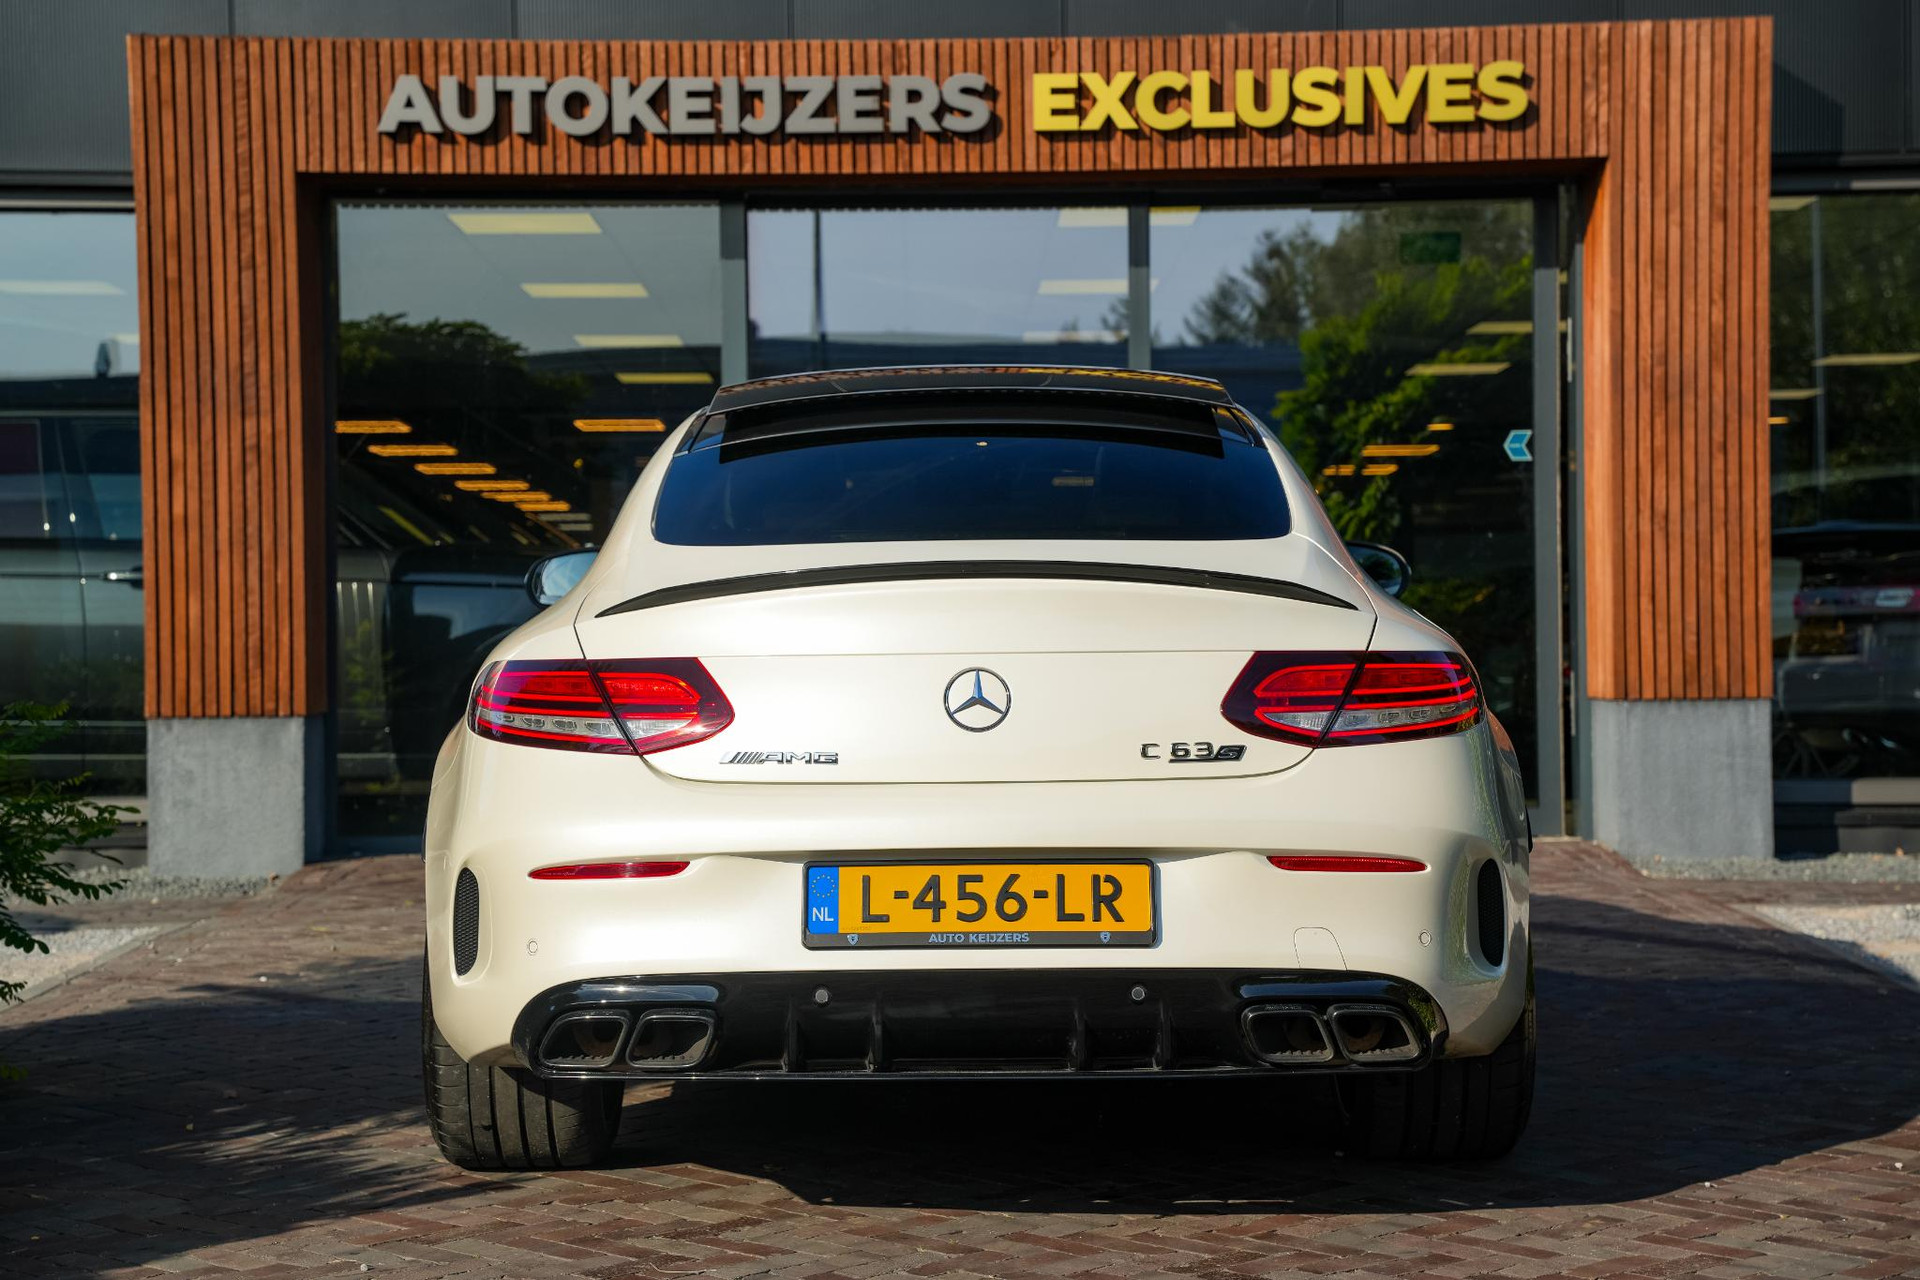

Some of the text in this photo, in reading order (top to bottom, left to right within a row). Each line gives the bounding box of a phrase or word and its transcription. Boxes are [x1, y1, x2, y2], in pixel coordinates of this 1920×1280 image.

[377, 60, 1529, 136] AUTOKEIJZERS EXCLUSIVES
[1140, 743, 1161, 760] C
[861, 873, 1125, 924] L-456-LR
[812, 907, 835, 922] NL
[928, 932, 1030, 943] AUTO KEIJZERS
